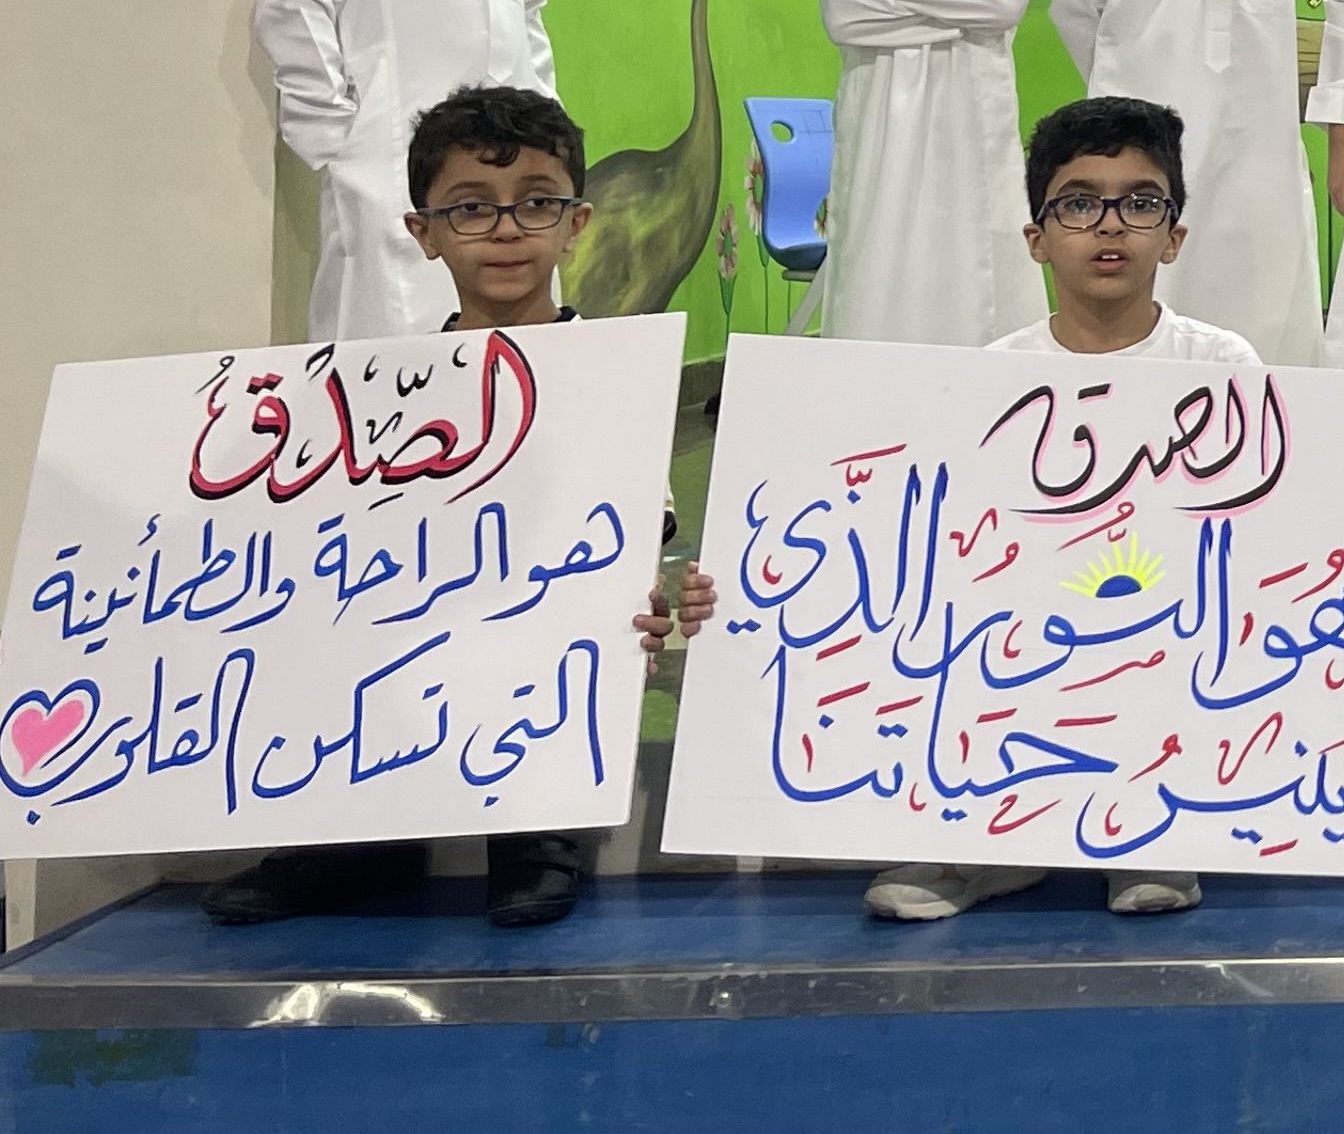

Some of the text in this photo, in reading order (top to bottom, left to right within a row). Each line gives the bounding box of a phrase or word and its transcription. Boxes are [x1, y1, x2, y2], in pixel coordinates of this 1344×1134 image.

[978, 373, 1291, 522] الصدق
[314, 502, 509, 626] الراحة
[252, 631, 452, 798] تسكن
[460, 638, 605, 808] التي
